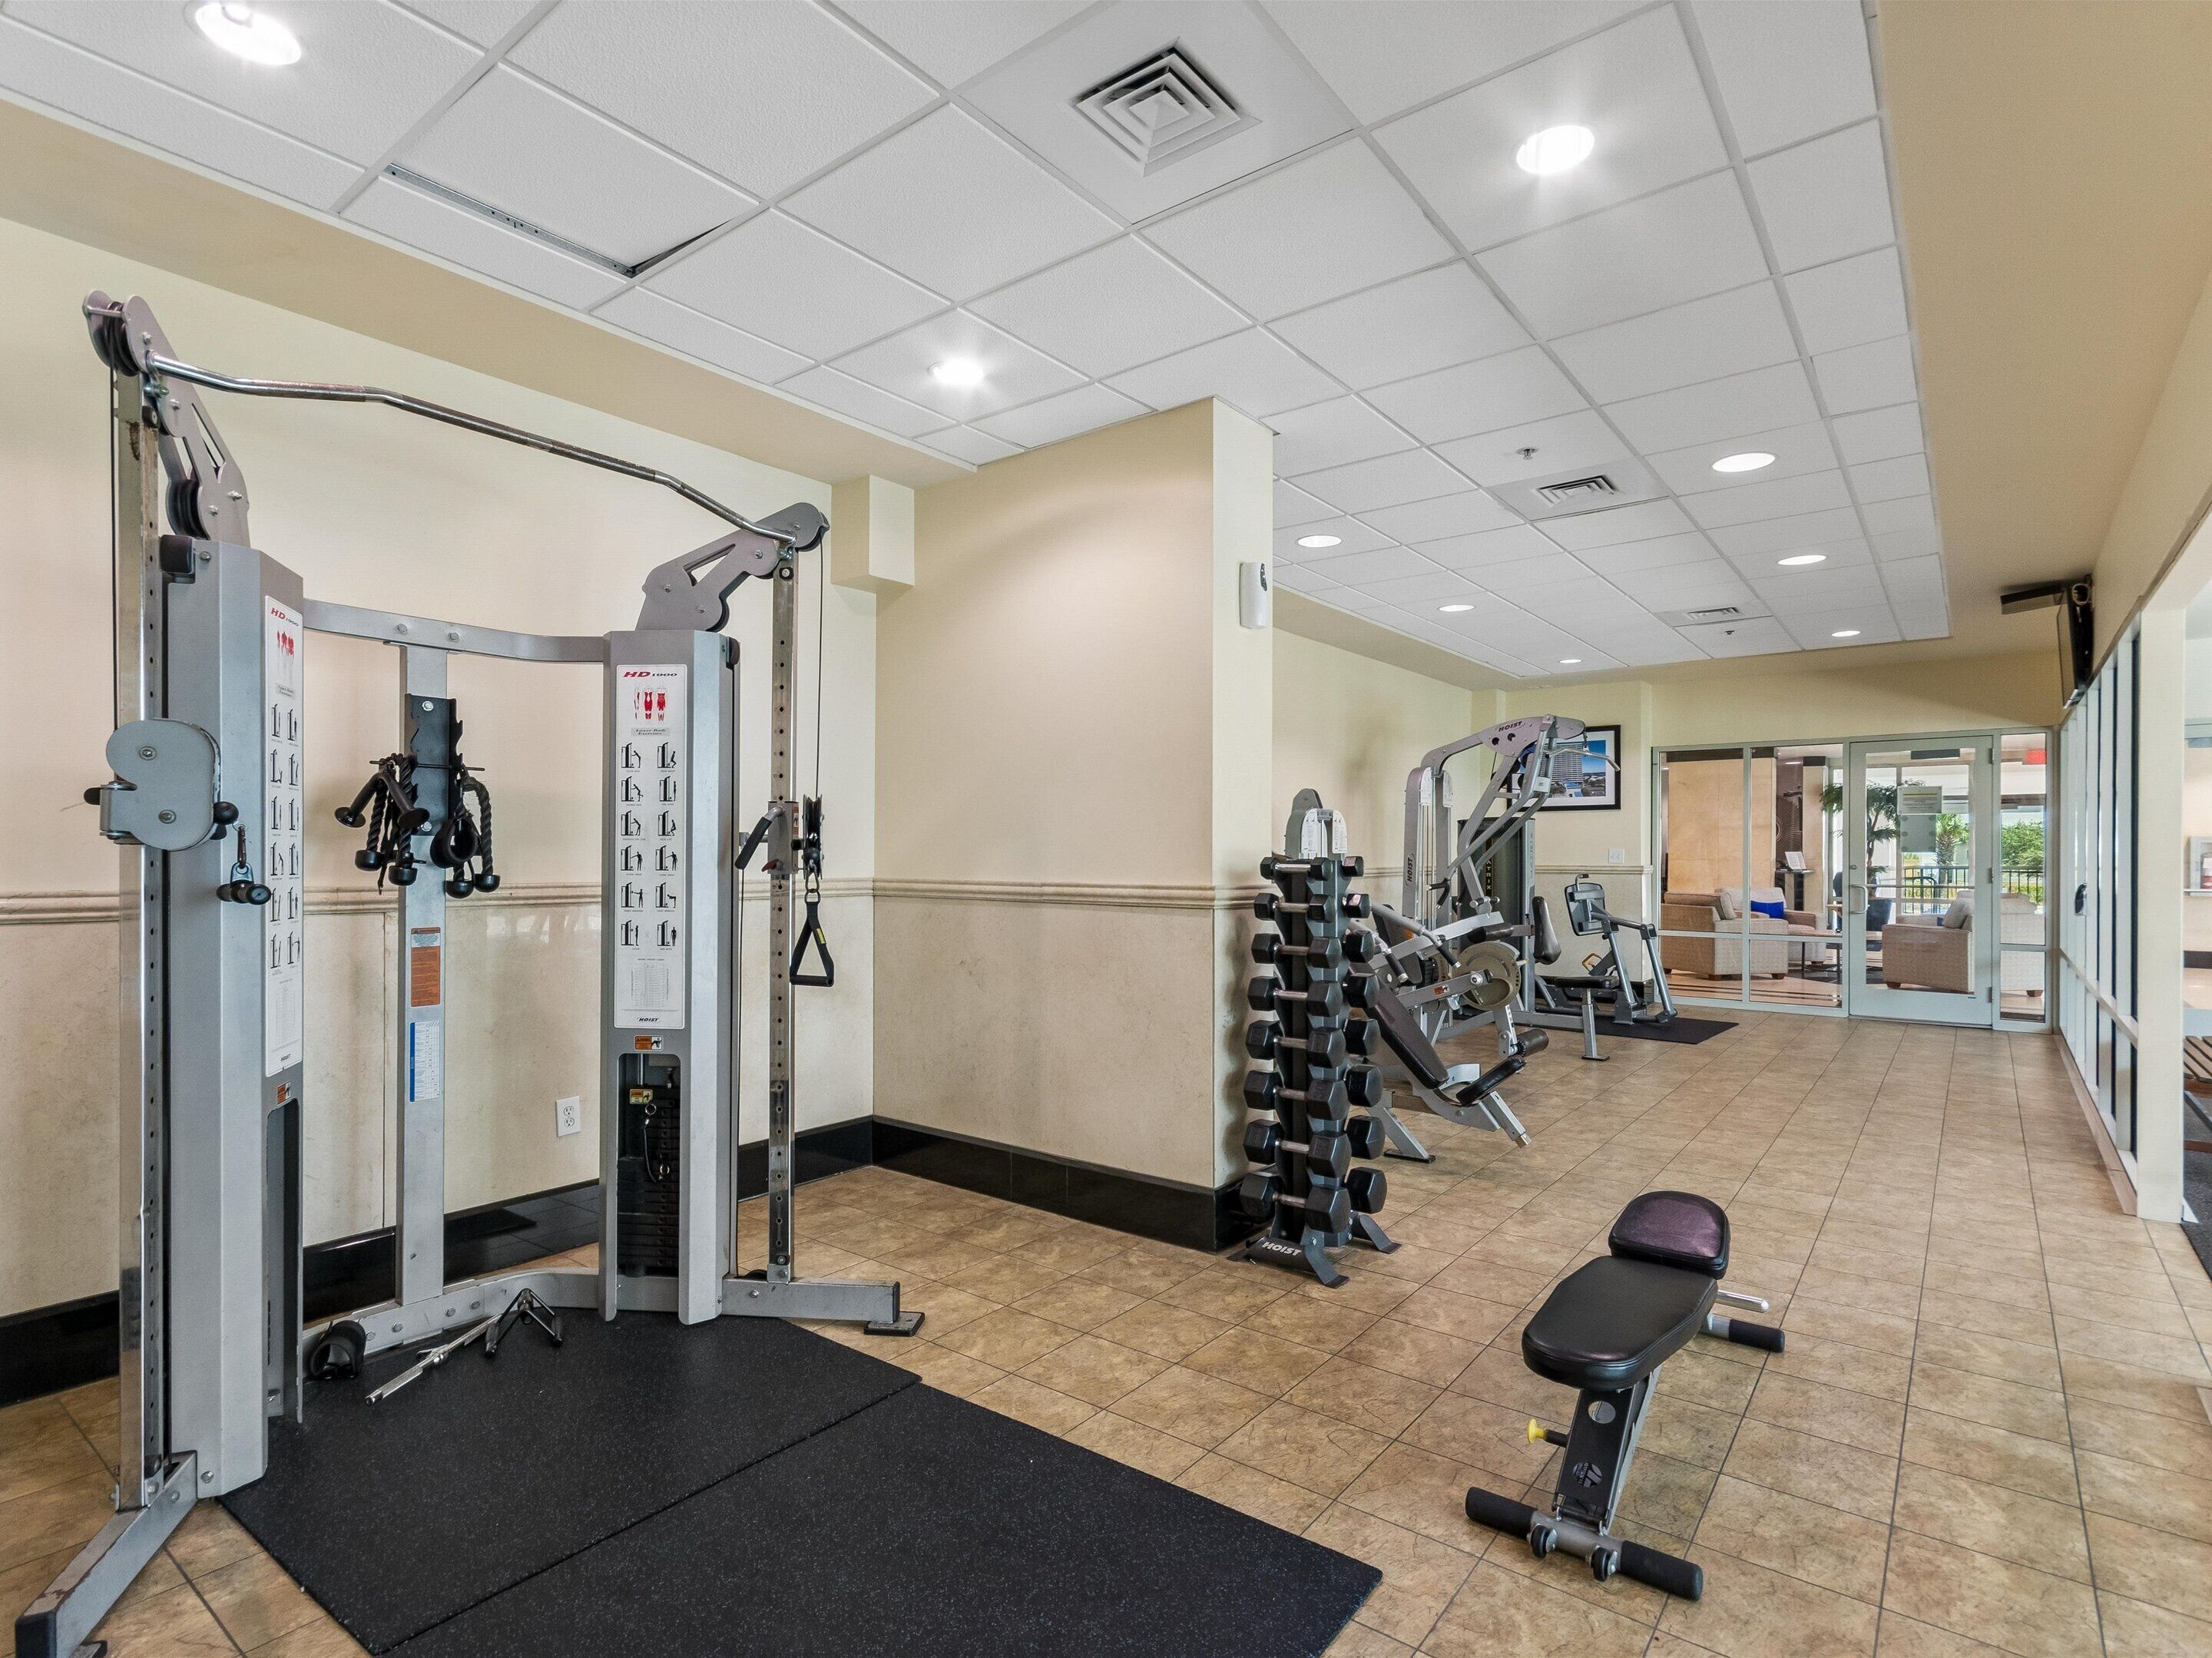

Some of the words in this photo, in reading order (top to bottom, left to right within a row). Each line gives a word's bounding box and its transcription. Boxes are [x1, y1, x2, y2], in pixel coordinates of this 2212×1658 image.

[270, 607, 286, 620] HD
[1498, 721, 1523, 733] HOIST
[1262, 1241, 1302, 1256] HOIST
